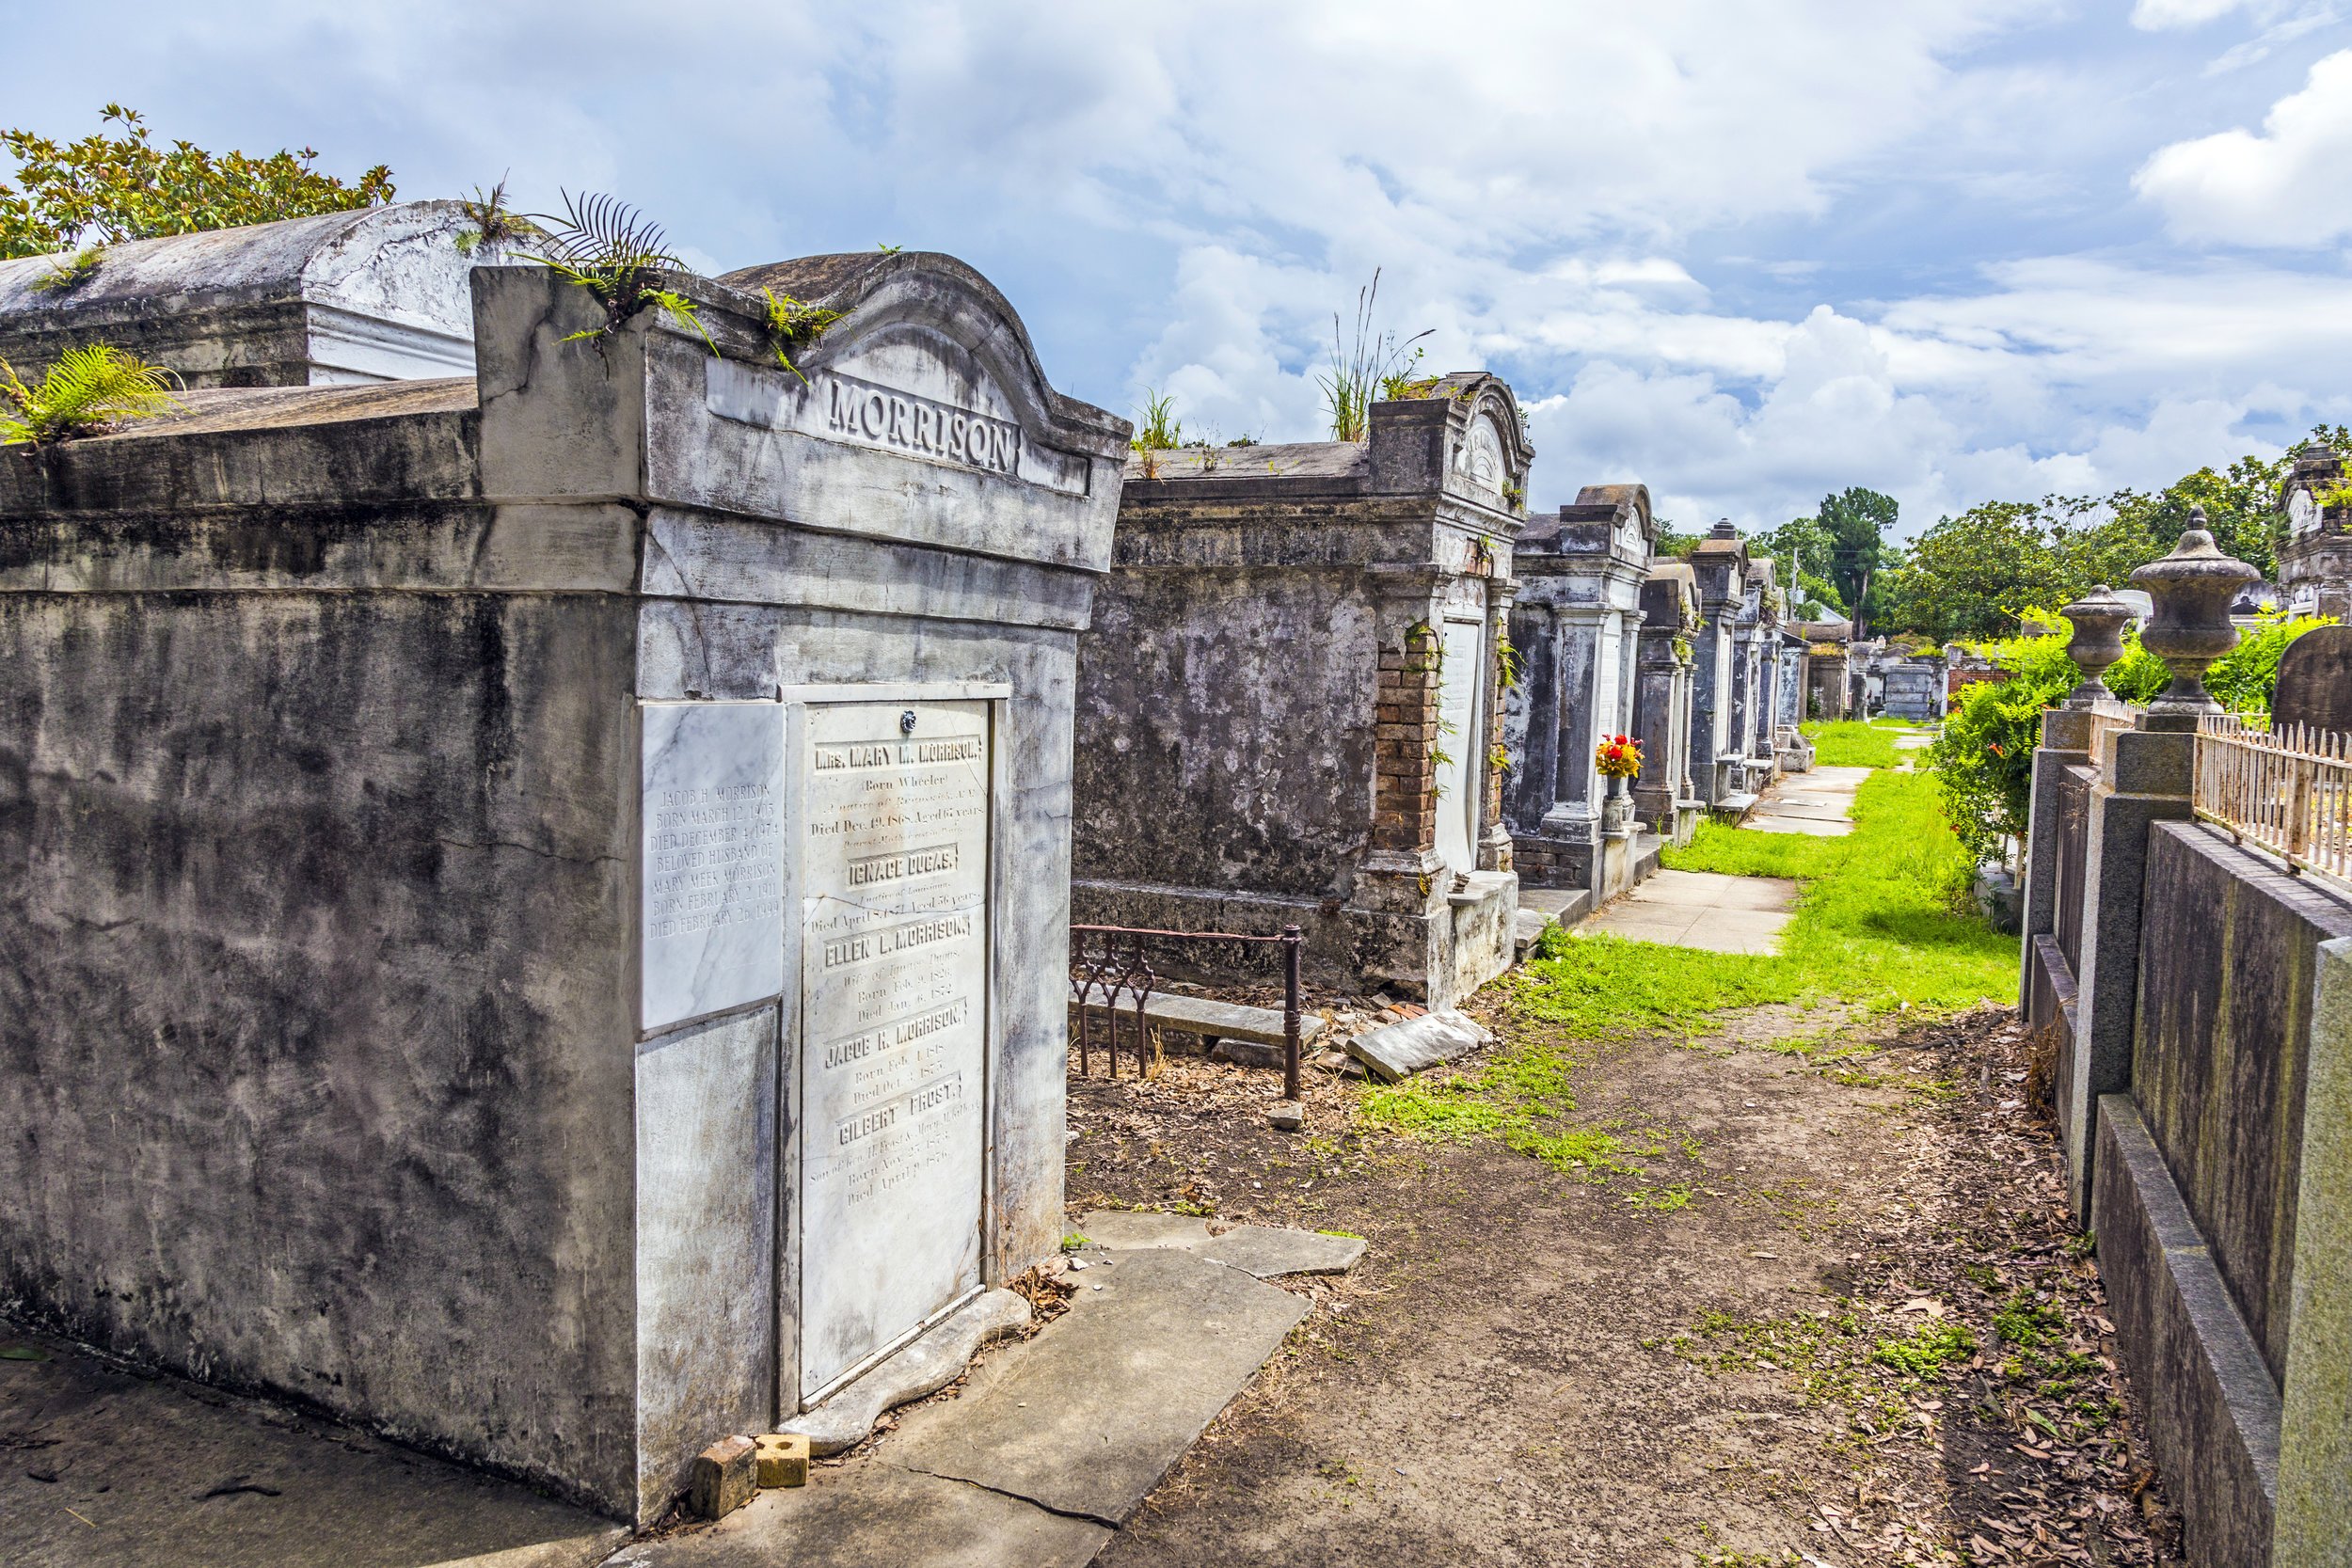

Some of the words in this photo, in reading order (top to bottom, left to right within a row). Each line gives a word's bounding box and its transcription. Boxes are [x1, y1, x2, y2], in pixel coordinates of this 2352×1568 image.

[829, 379, 1013, 472] MORRISON
[850, 745, 895, 768] MARY
[898, 744, 914, 765] M.
[660, 789, 696, 808] JACOB
[716, 784, 771, 802] MORRISON
[655, 811, 686, 831] BORN
[691, 807, 728, 826] MARCH
[750, 802, 774, 820] 1905
[810, 821, 839, 836] Died
[649, 834, 677, 853] DIED
[681, 827, 737, 848] DECEMBER
[755, 822, 779, 839] 1974
[656, 851, 705, 874] BELOVED
[708, 845, 757, 866] HUSBAND
[761, 842, 773, 859] OF
[653, 875, 686, 895] MARY
[691, 871, 719, 889] MEEK
[723, 862, 775, 883] MORRISON
[849, 858, 902, 887] IGNACE
[653, 897, 684, 918] BORN
[687, 888, 740, 911] FEBRUARY
[757, 882, 776, 900] 1911
[649, 920, 676, 940] DIED
[679, 910, 733, 934] FEBRUARY
[755, 900, 779, 920] 1999
[811, 917, 837, 933] Died
[842, 911, 870, 929] April
[825, 939, 871, 968] ELLEN
[880, 934, 893, 956] L.
[871, 967, 885, 982] of
[857, 988, 887, 1004] Born
[857, 1005, 882, 1023] Died
[825, 1035, 871, 1069] JACOB
[855, 1068, 884, 1085] Born
[852, 1083, 881, 1105] Died
[839, 1102, 899, 1146] GILBERT
[809, 1171, 829, 1185] Son
[848, 1166, 879, 1187] Born
[848, 1184, 874, 1206] Died
